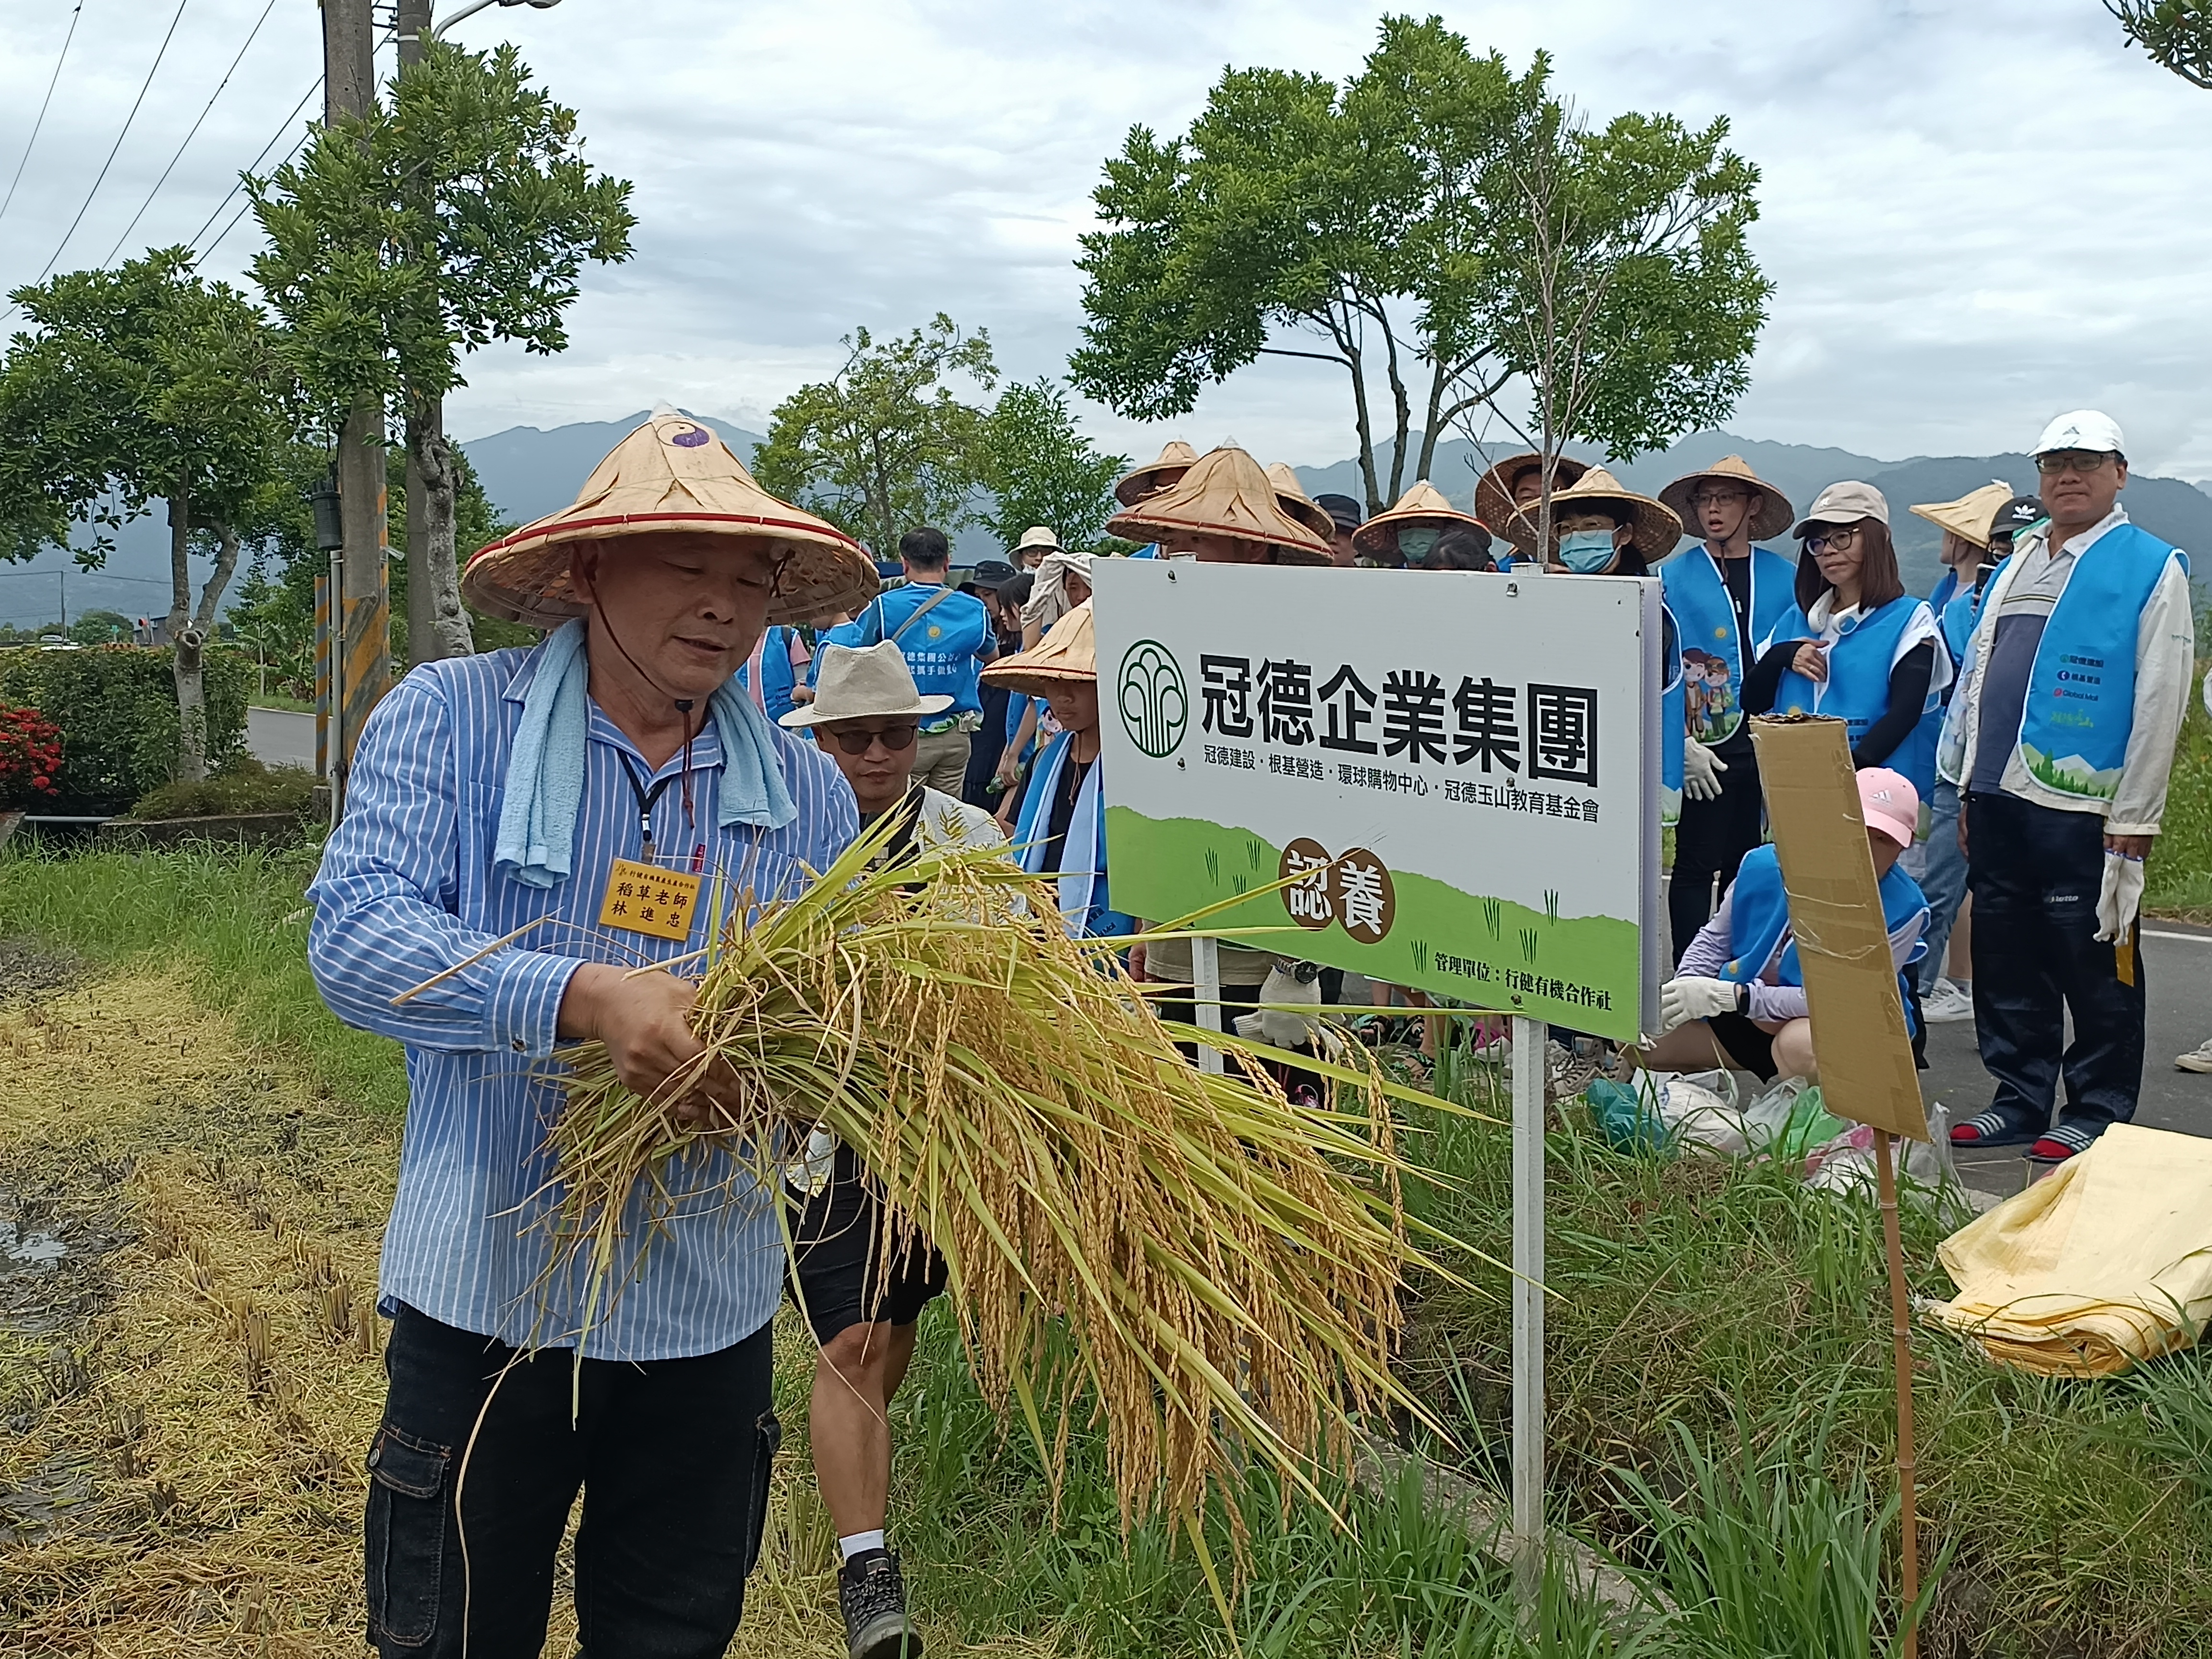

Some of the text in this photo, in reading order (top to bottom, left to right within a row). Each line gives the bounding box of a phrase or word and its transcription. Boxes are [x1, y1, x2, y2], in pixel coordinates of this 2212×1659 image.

[2063, 689, 2085, 699] Global
[1200, 653, 1599, 788] 冠德企業集團
[616, 882, 688, 909] 稻草老師
[1287, 849, 1386, 935] 認養
[611, 900, 680, 927] 林進忠
